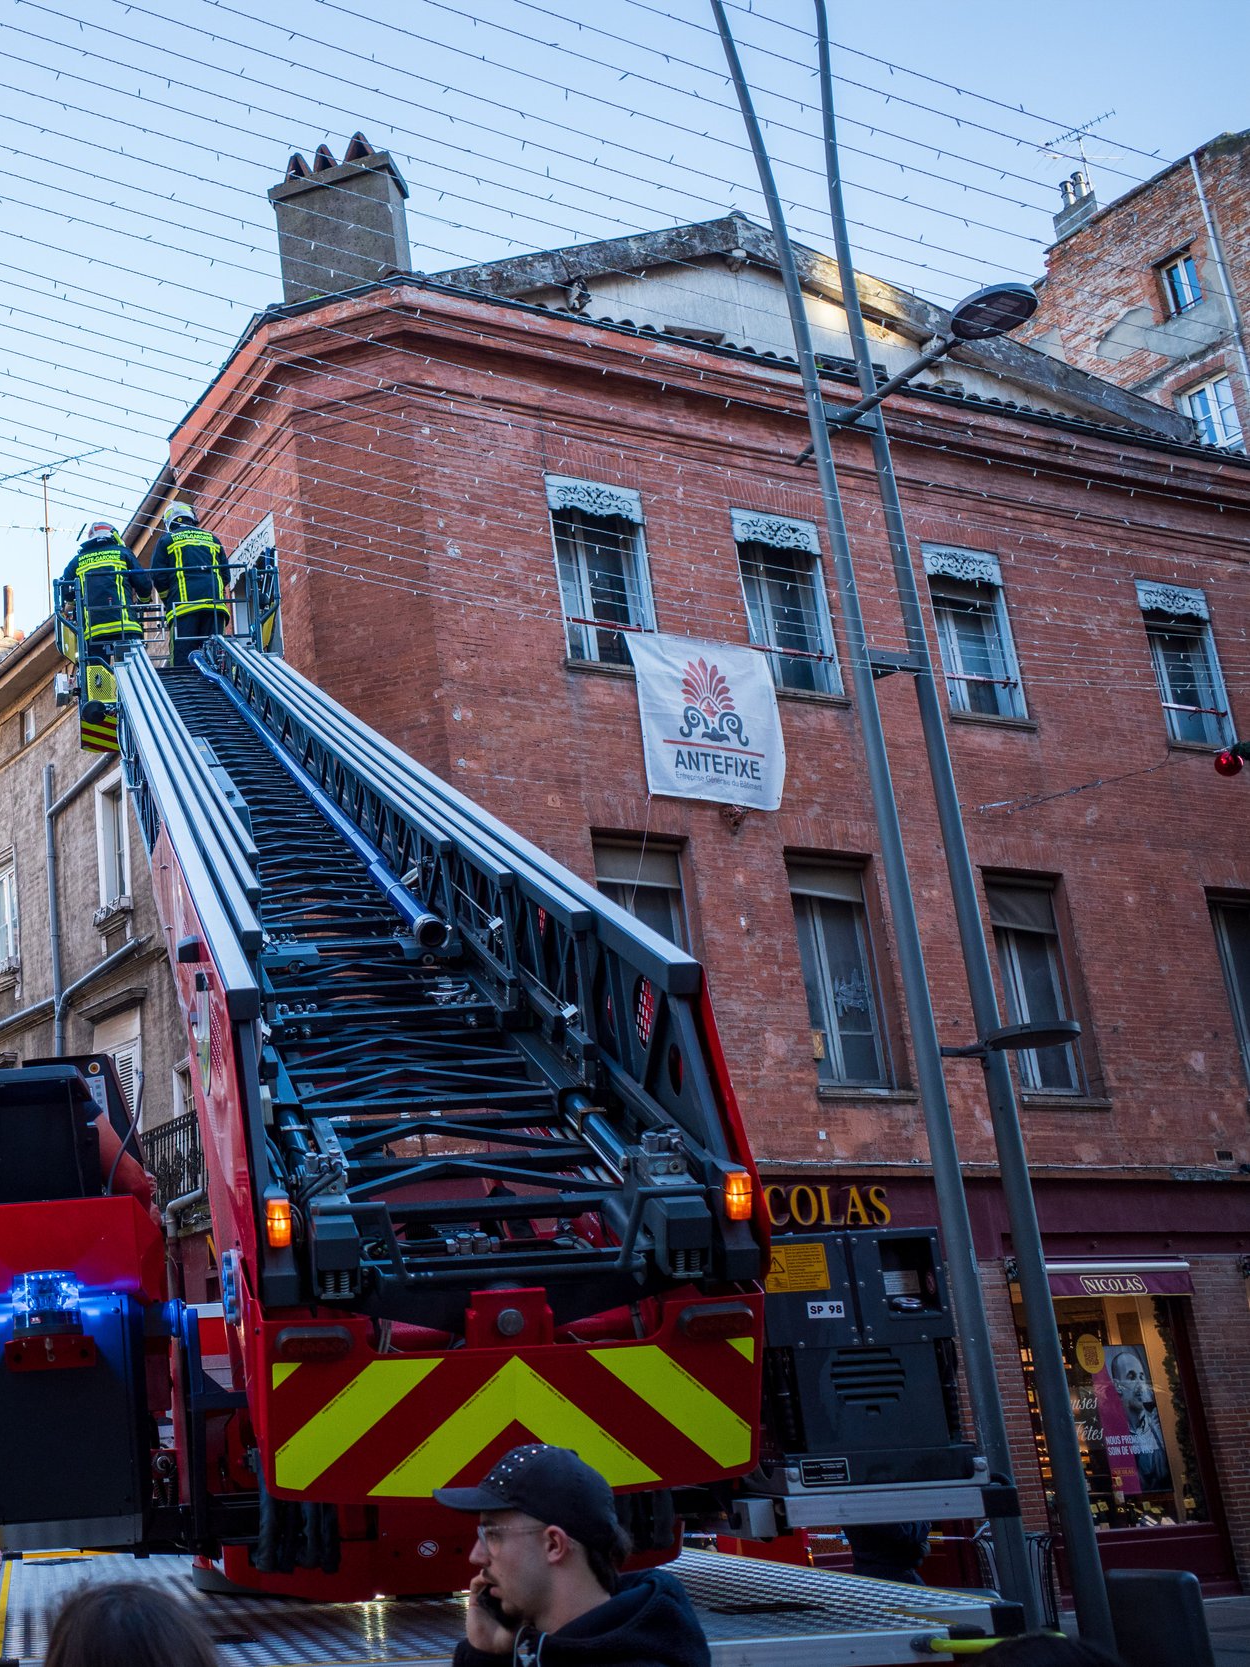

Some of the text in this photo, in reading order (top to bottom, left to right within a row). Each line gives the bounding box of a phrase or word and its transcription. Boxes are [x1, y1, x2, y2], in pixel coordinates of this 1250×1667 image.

[675, 750, 761, 780] ANTEFIXE
[1084, 1278, 1143, 1292] NICOLAS
[810, 1303, 842, 1315] SP 98
[1071, 1397, 1098, 1410] uses
[1105, 1435, 1121, 1446] NOUS
[1107, 1446, 1122, 1456] SOIN
[1121, 1446, 1130, 1455] DE
